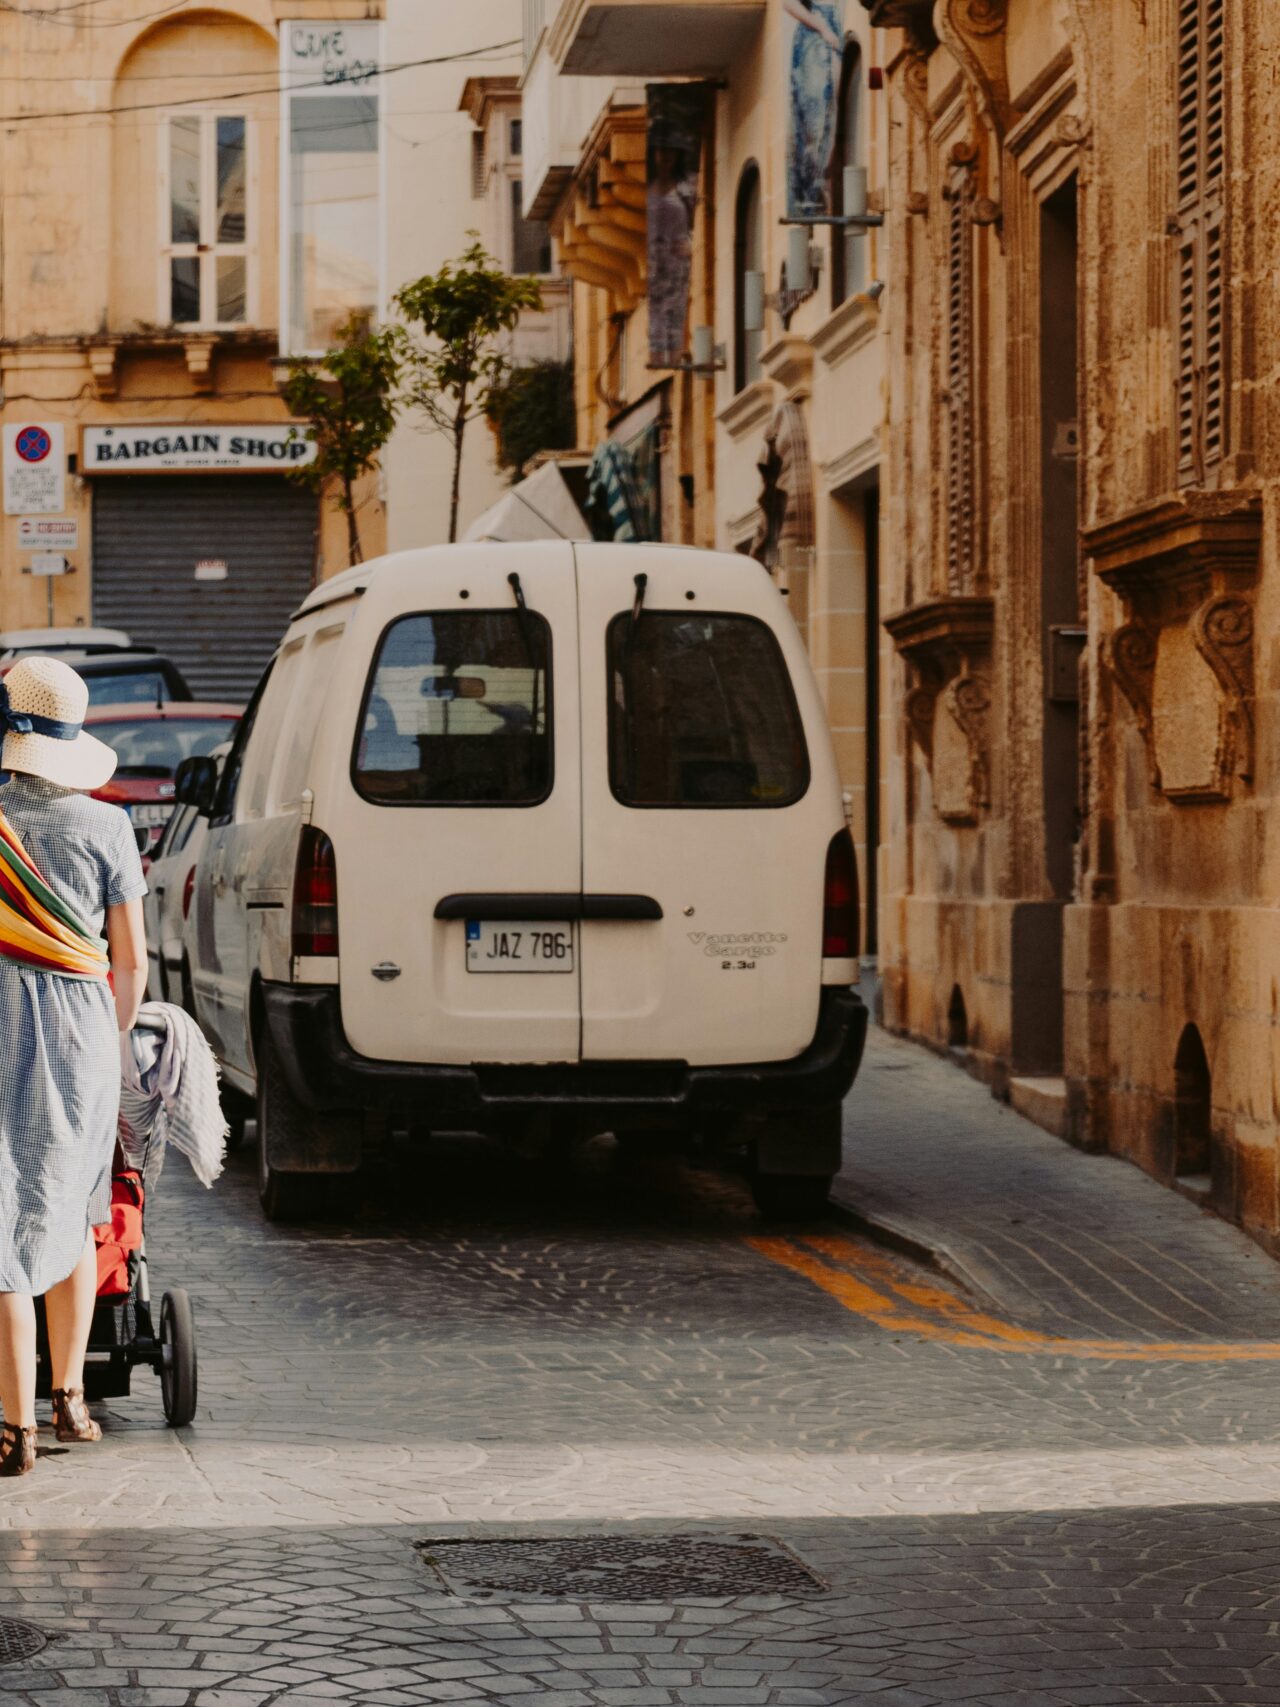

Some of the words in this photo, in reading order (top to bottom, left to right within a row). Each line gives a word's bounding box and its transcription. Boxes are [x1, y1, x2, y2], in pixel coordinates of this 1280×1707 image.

[96, 434, 221, 462] BARGAIN
[229, 437, 307, 460] SHOP
[486, 932, 522, 959] JAZ
[530, 932, 565, 959] 786
[687, 931, 788, 944] Vanette
[721, 960, 756, 970] 2.3d
